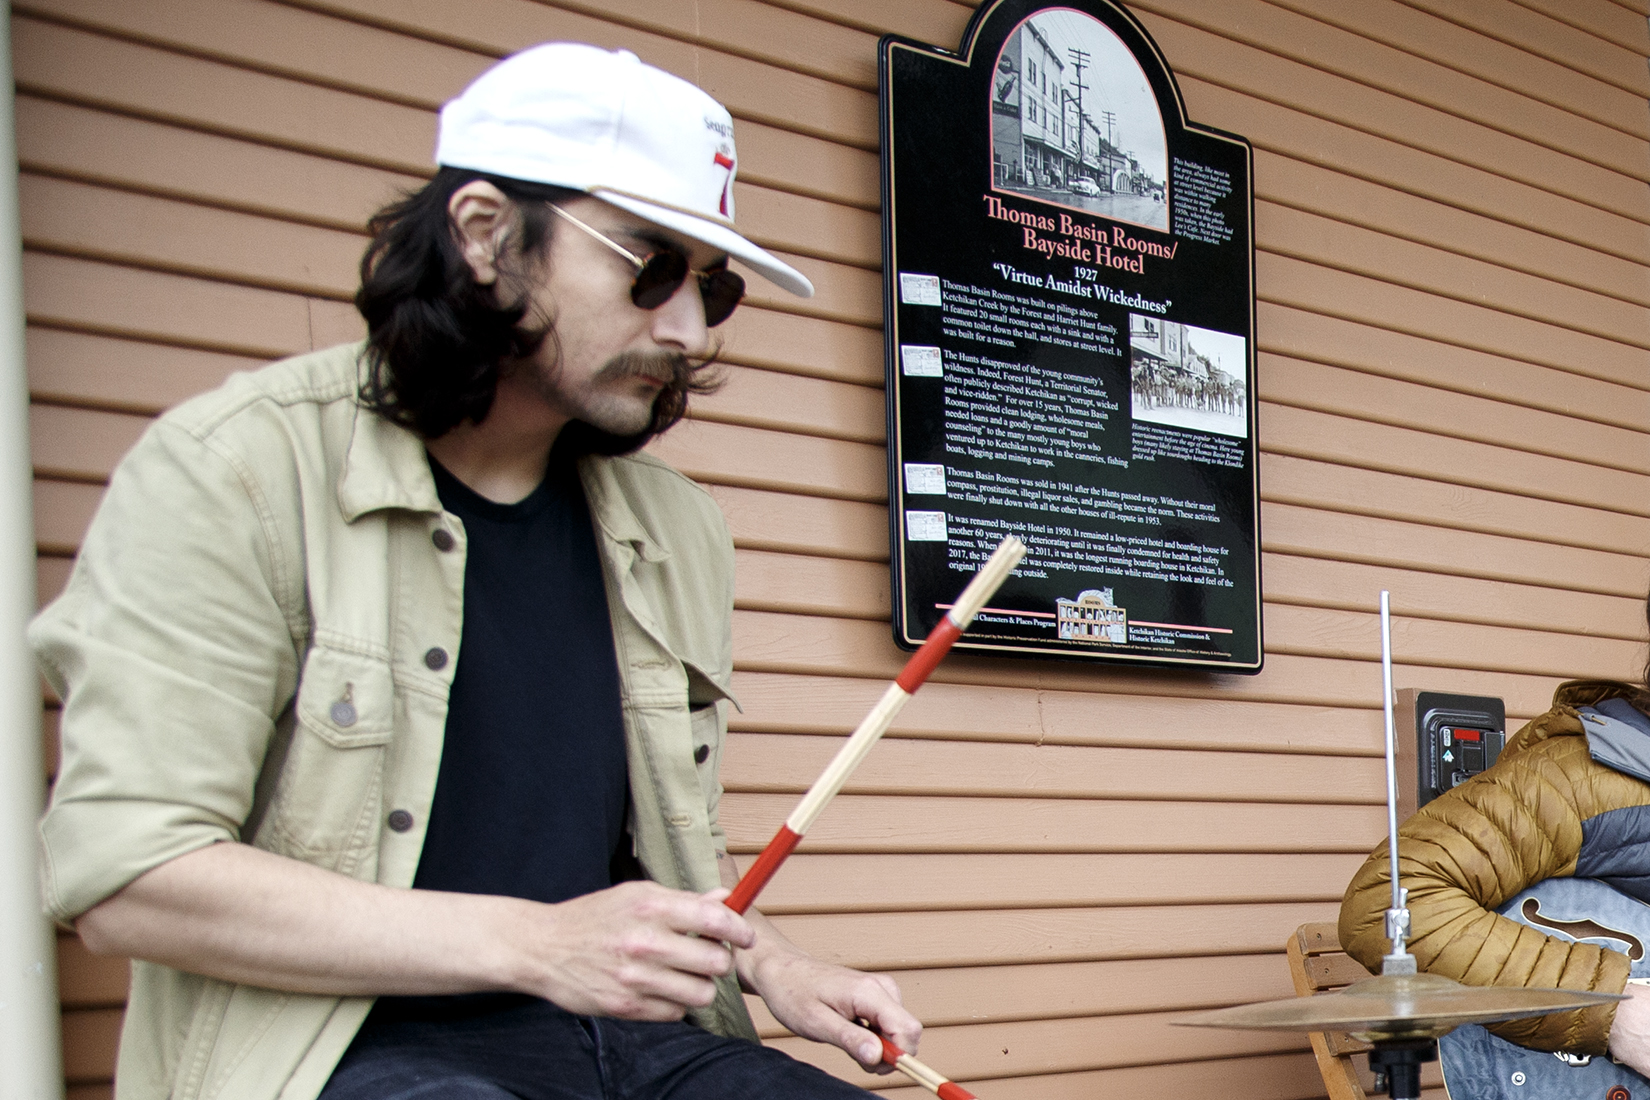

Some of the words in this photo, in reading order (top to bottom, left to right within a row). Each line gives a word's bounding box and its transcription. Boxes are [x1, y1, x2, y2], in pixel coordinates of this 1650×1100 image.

[714, 152, 735, 218] 7
[983, 194, 1055, 233] Thomas
[1060, 212, 1108, 245] Basin
[1112, 225, 1178, 260] Rooms/
[1023, 227, 1091, 263] Bayside
[1095, 244, 1145, 275] Hotel
[993, 263, 1043, 289] "Virtue
[1045, 275, 1092, 299] Amidst
[1093, 284, 1172, 314] Wickedness"
[1074, 265, 1098, 282] 1927
[942, 290, 976, 305] Ketchikan
[978, 298, 998, 309] Creek
[1010, 304, 1020, 314] the
[1022, 306, 1041, 318] Forest
[1043, 312, 1055, 320] and
[1056, 313, 1078, 325] Harriet
[1080, 318, 1095, 328] Hunt
[1097, 321, 1117, 335] family.
[943, 279, 969, 292] Thomas
[971, 285, 990, 296] Basin
[992, 289, 1015, 302] Rooms
[1030, 297, 1045, 308] built
[1056, 303, 1078, 316] pilings
[1079, 308, 1097, 318] above
[943, 317, 972, 327] common
[974, 321, 991, 331] toilet
[992, 324, 1011, 335] down
[1013, 328, 1023, 337] the
[1024, 330, 1038, 341] hall,
[1040, 334, 1051, 342] and
[1053, 337, 1071, 346] stores
[1080, 342, 1097, 351] street
[1098, 344, 1115, 354] level.
[950, 304, 977, 317] featured
[989, 314, 1007, 323] small
[1008, 318, 1029, 327] rooms
[1030, 322, 1045, 330] each
[1047, 324, 1061, 333] with
[1068, 328, 1080, 337] sink
[1082, 331, 1093, 340] and
[1095, 334, 1108, 342] with
[958, 329, 973, 339] built
[975, 332, 985, 341] for
[992, 338, 1015, 347] reason.
[943, 362, 975, 374] wildness.
[977, 367, 1001, 380] Indeed,
[1003, 372, 1023, 383] Forest
[1025, 375, 1043, 387] Hunt,
[1050, 380, 1081, 393] Territorial
[1083, 385, 1107, 398] Senator,
[944, 349, 957, 359] The
[959, 352, 978, 363] Hunts
[980, 356, 1020, 371] disapproved
[1030, 365, 1040, 374] the
[1042, 370, 1061, 380] young
[1063, 373, 1103, 386] community's
[943, 373, 961, 383] often
[963, 378, 990, 391] publicly
[992, 381, 1023, 394] described
[1025, 387, 1057, 400] Ketchikan
[1096, 400, 1118, 410] wicked
[947, 467, 973, 478] Thomas
[976, 471, 994, 481] Basin
[996, 474, 1019, 484] Rooms
[1035, 480, 1048, 488] sold
[1058, 482, 1072, 491] 1941
[1074, 485, 1089, 494] after
[1090, 487, 1100, 495] the
[1101, 488, 1119, 498] Hunts
[1121, 493, 1141, 501] passed
[1160, 497, 1183, 507] Without
[1184, 500, 1197, 509] their
[1033, 619, 1056, 628] Program
